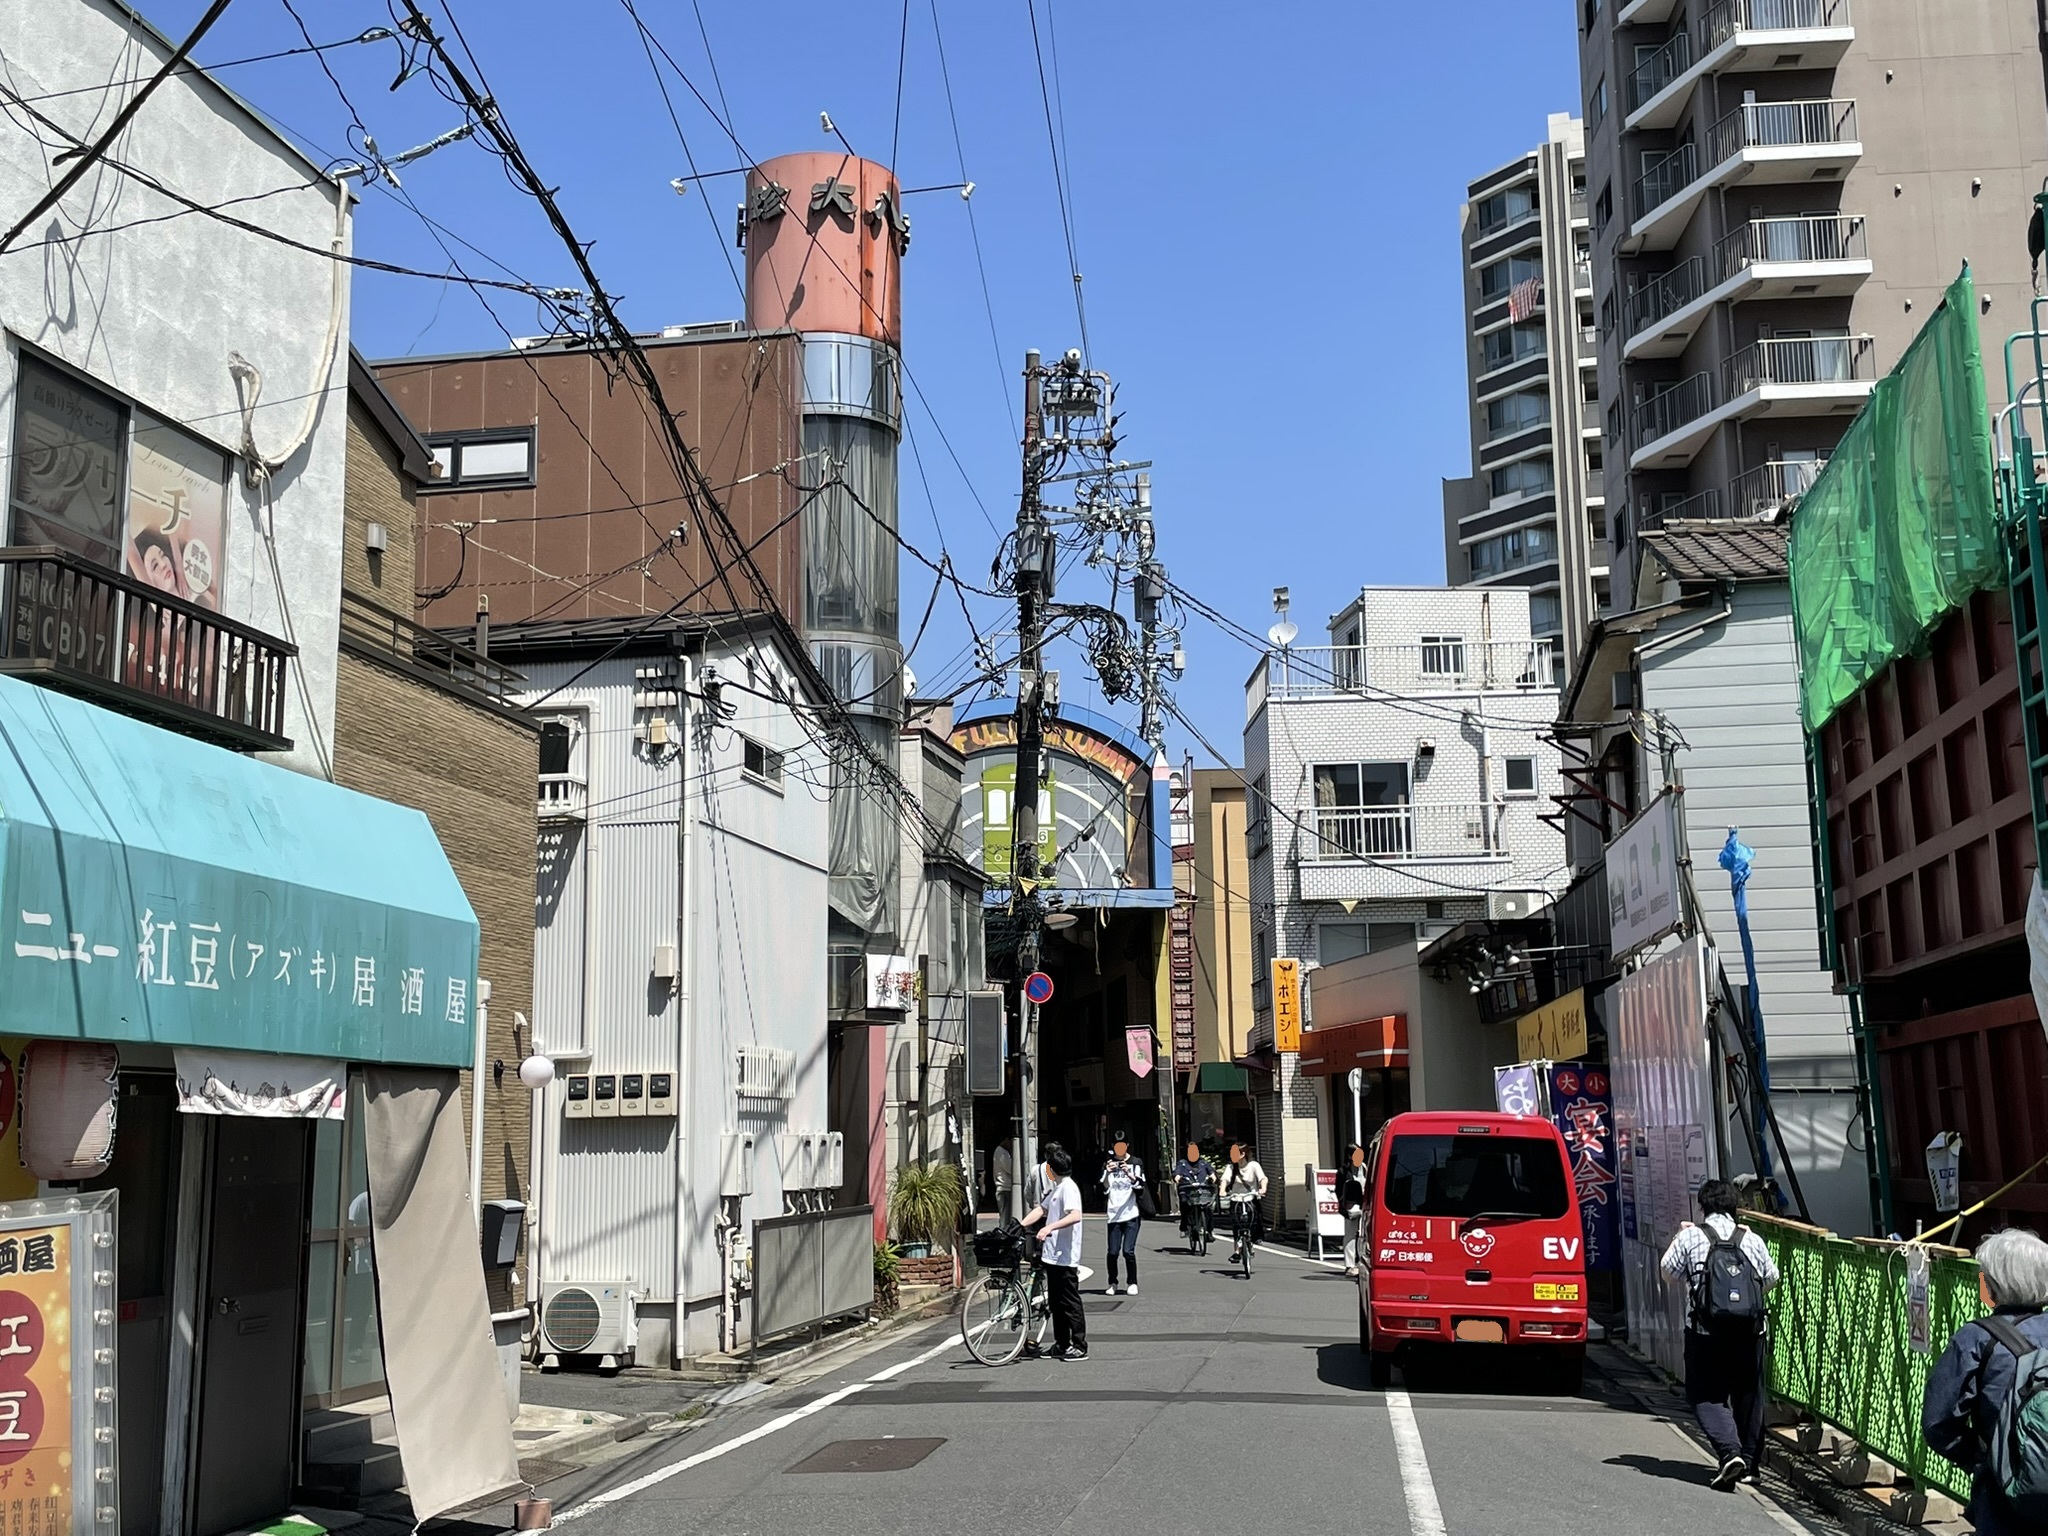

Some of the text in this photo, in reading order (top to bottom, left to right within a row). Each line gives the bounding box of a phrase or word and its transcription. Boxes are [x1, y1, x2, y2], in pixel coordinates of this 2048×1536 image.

[1398, 1251, 1433, 1263] 日本郵便
[1543, 1236, 1579, 1261] EV
